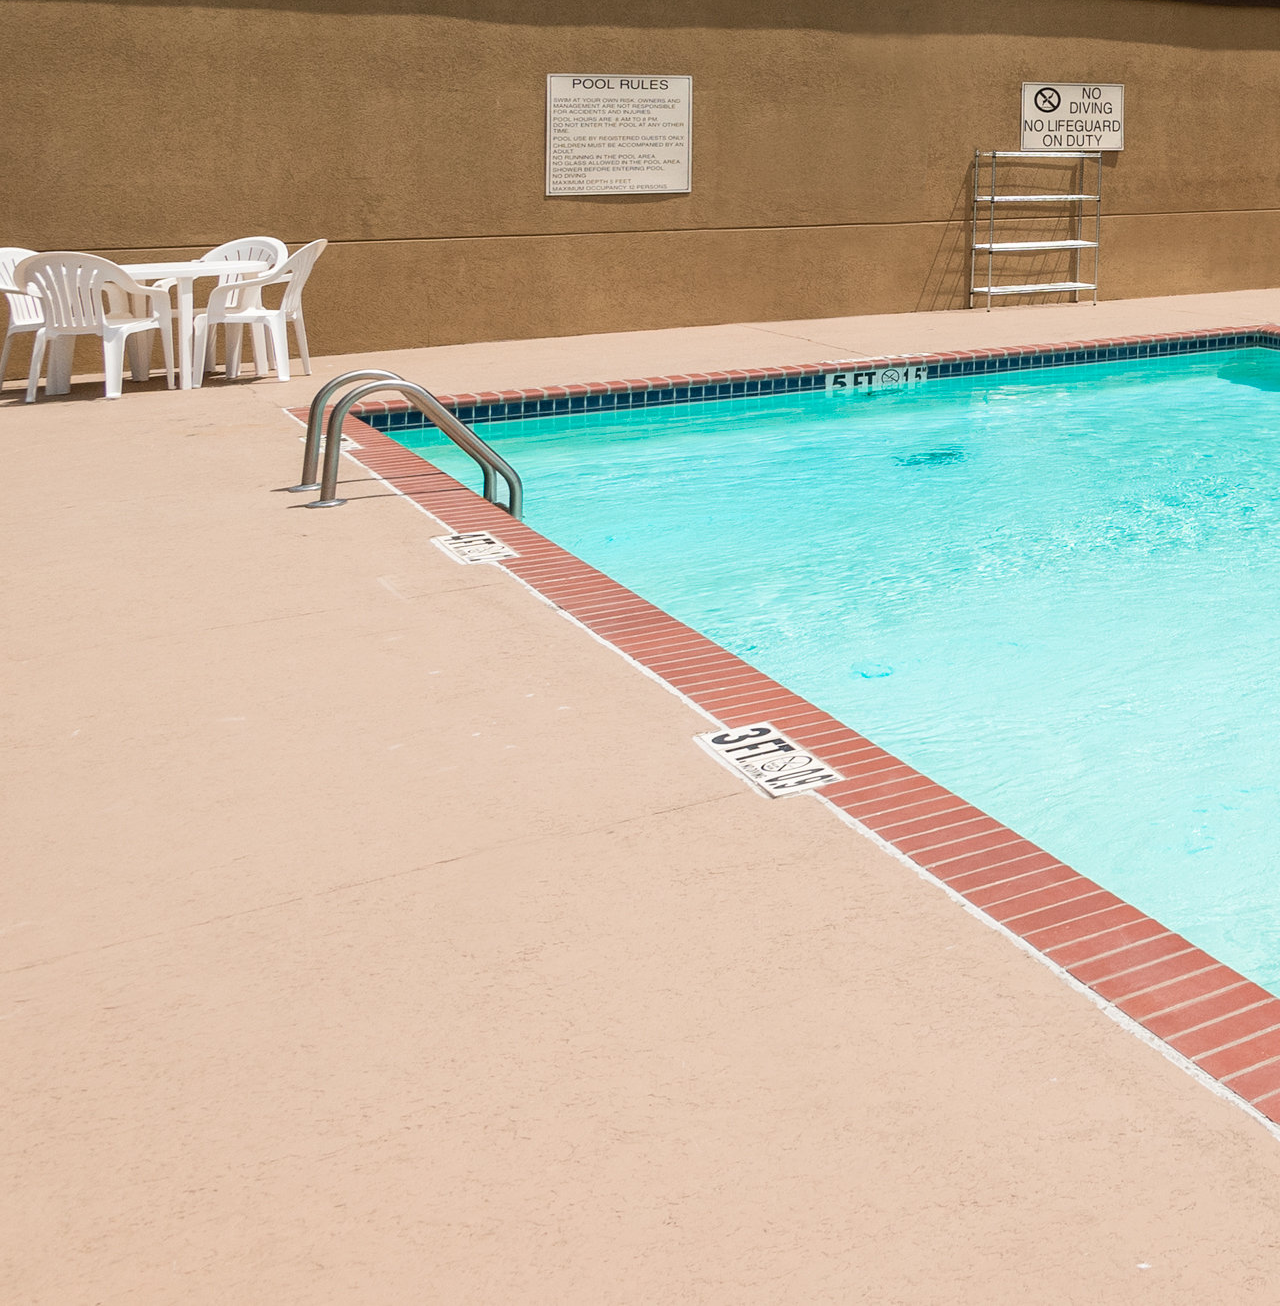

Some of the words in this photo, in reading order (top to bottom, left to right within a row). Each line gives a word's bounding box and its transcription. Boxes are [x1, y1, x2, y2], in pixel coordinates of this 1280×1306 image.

[572, 78, 615, 89] POOL
[620, 79, 669, 90] RULES
[1082, 87, 1102, 100] NO
[1070, 102, 1113, 114] DIVING
[1024, 120, 1044, 132] NO
[1048, 120, 1121, 132] LIFEGUARD
[1043, 135, 1063, 147] ON
[1067, 135, 1103, 147] DUTY
[833, 374, 847, 388] 5
[854, 371, 876, 386] FT
[711, 727, 772, 745] 3
